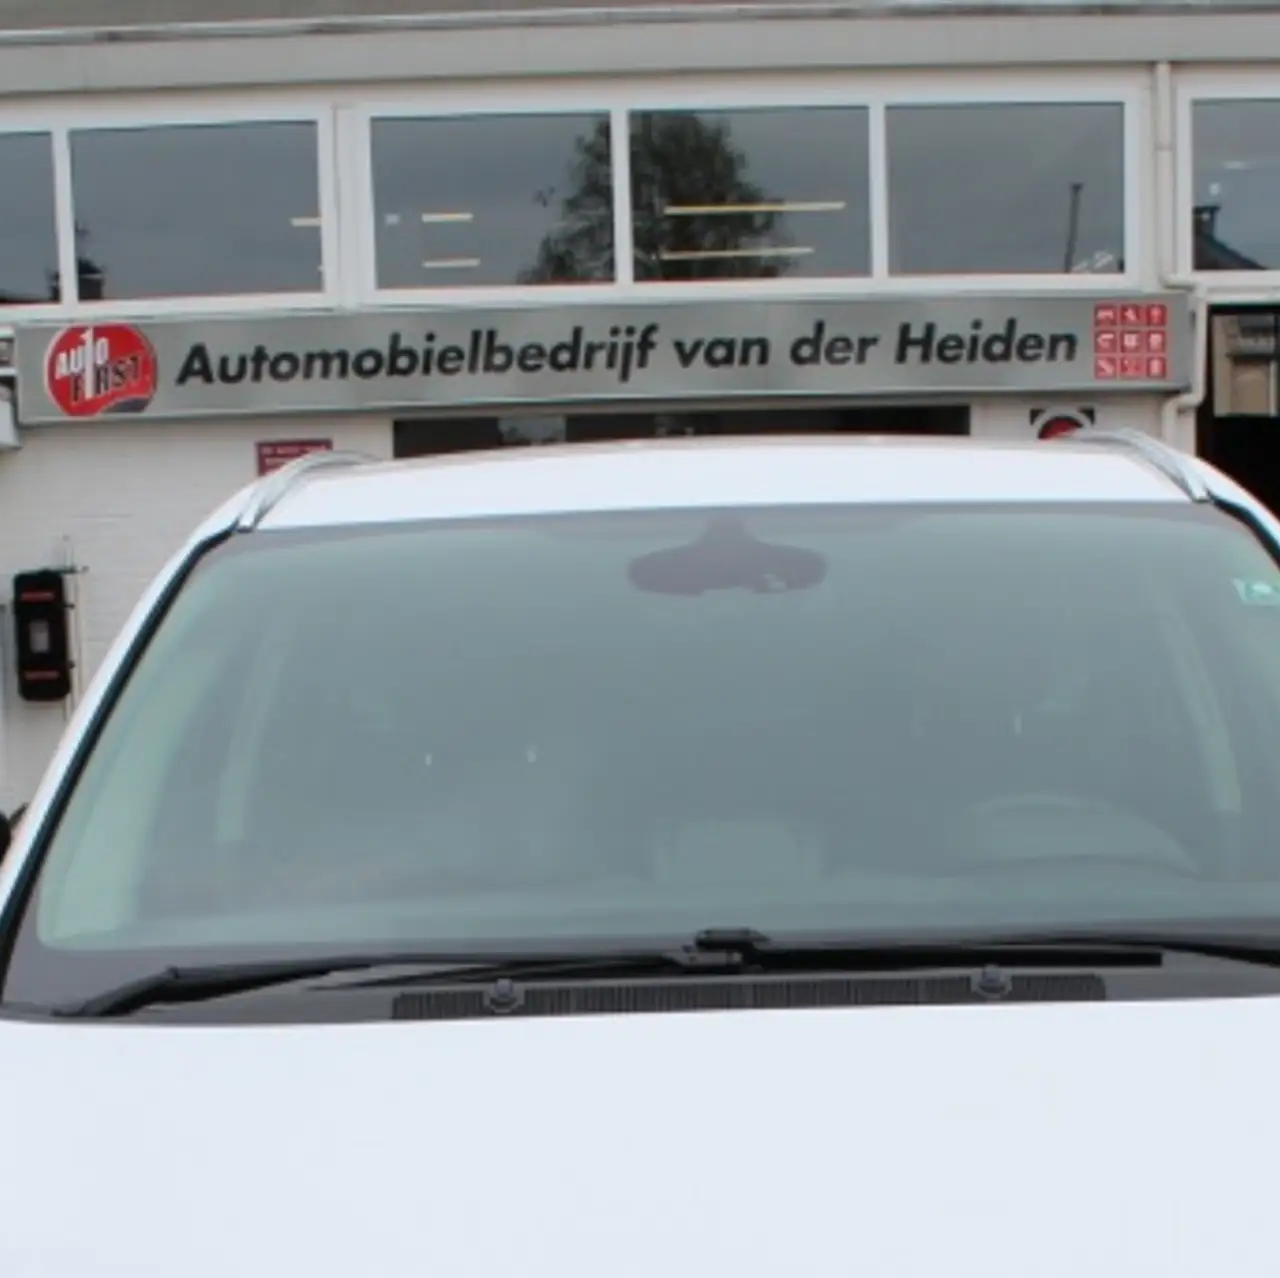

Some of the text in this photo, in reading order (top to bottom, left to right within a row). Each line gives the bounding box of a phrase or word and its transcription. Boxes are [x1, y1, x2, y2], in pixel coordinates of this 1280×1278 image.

[175, 316, 1078, 386] Automobielbedrijf van der Heiden
